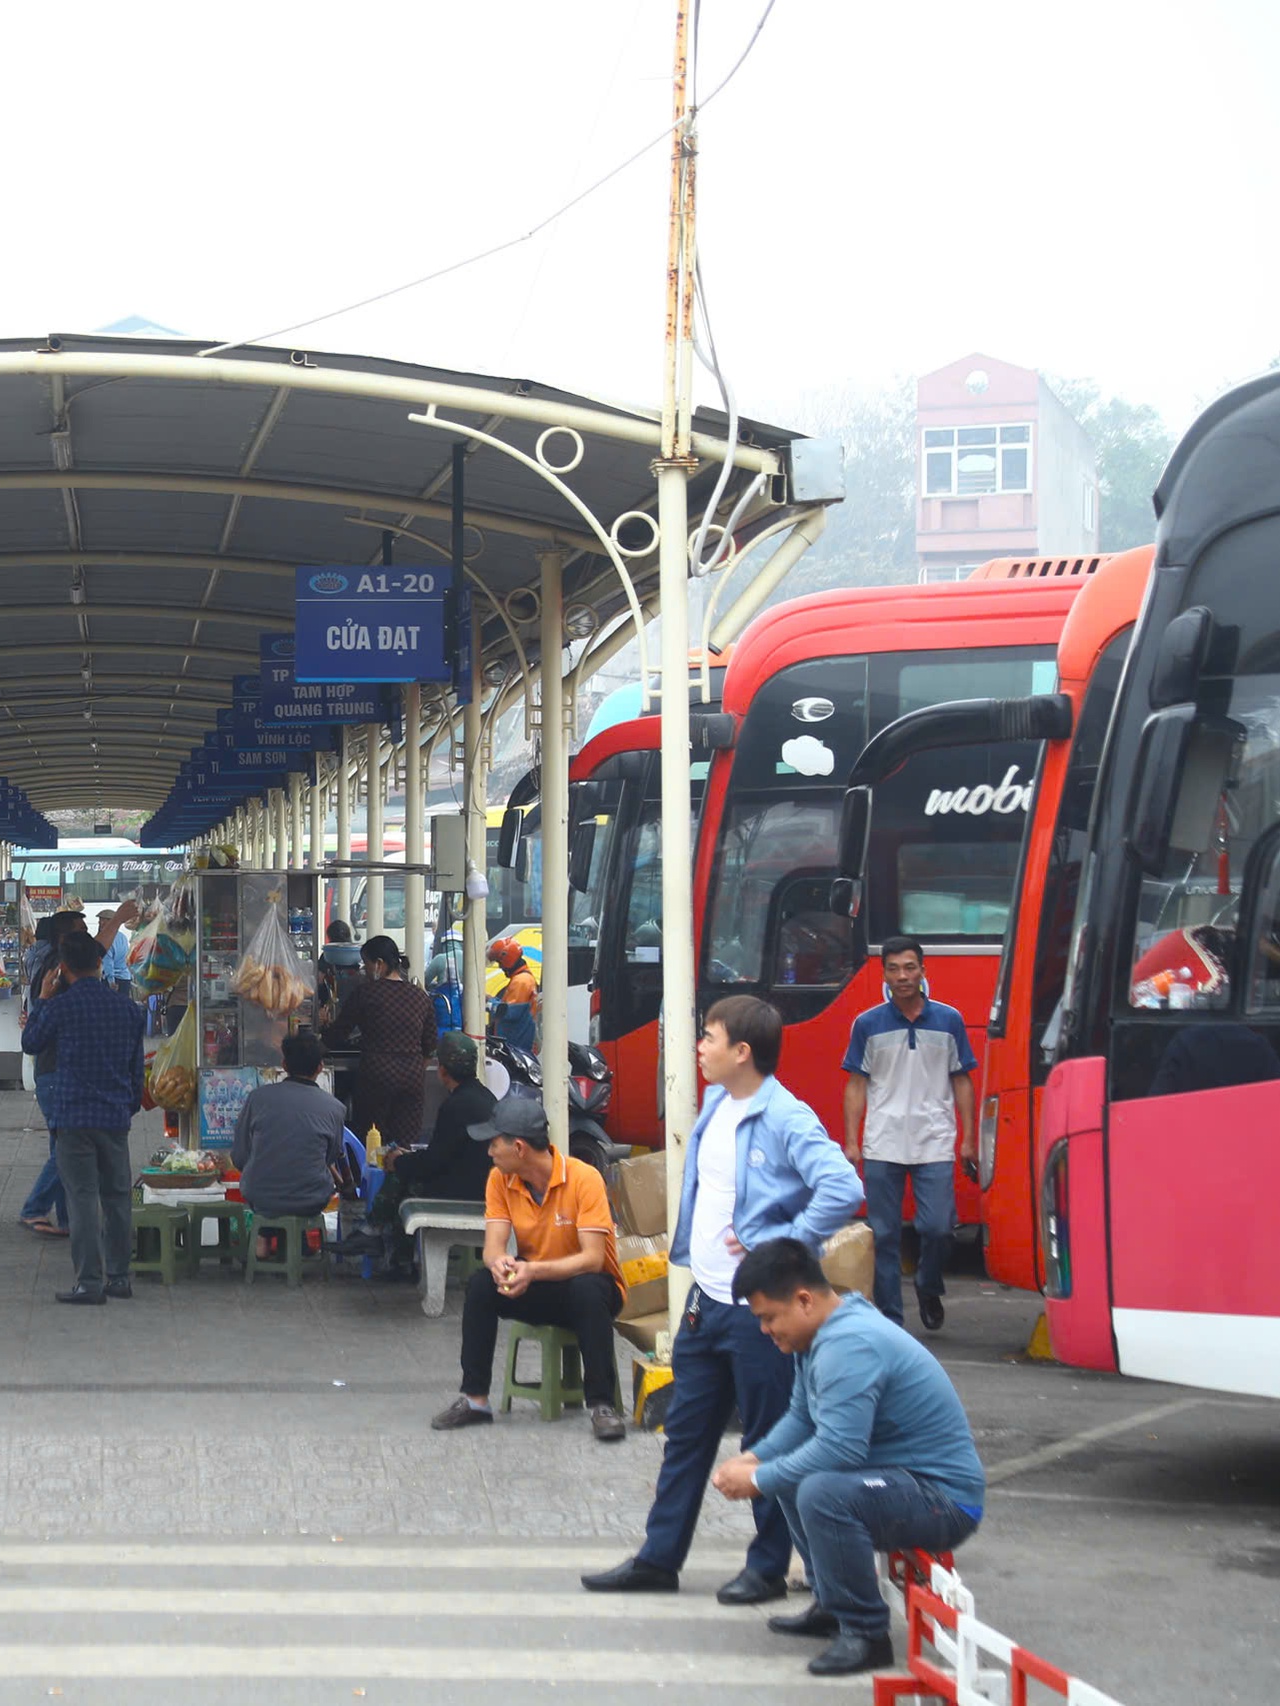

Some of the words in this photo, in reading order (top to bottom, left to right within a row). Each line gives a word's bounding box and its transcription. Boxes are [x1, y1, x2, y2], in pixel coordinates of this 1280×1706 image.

[357, 574, 435, 593] A1-20
[326, 618, 371, 650] CỬA
[377, 626, 420, 655] ĐẠT
[292, 685, 321, 699] TAM
[326, 684, 356, 700] HỢP
[274, 703, 323, 718] QUANG
[326, 702, 375, 716] TRUNG
